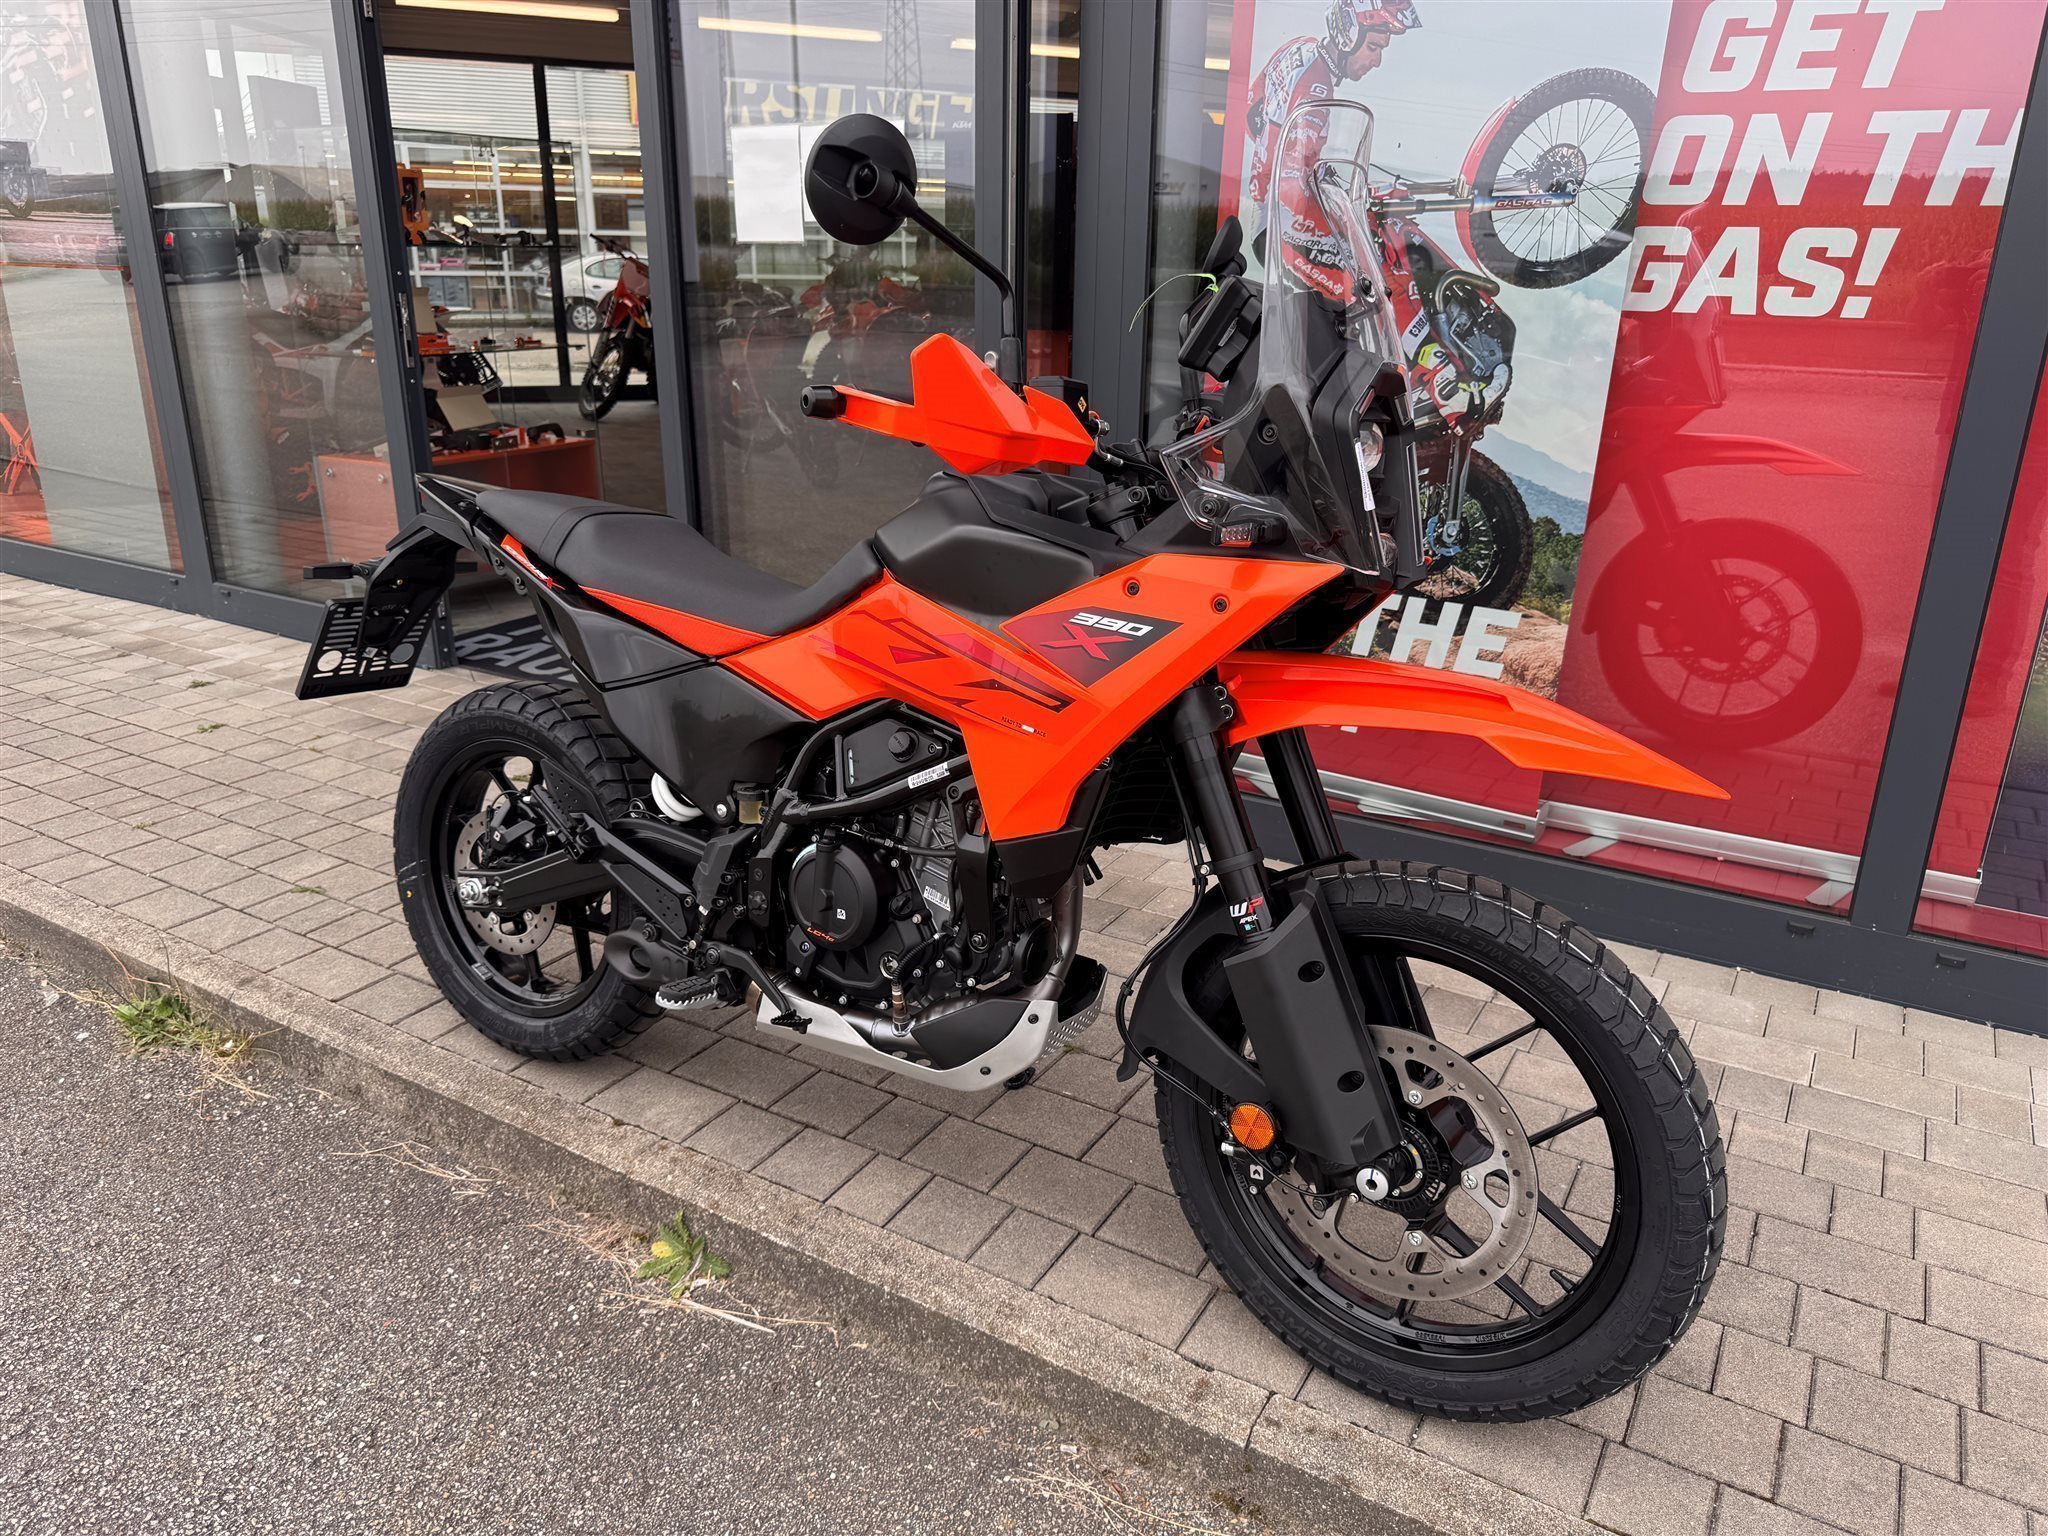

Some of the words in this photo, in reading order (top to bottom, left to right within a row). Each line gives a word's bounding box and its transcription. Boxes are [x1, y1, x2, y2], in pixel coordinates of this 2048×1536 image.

[1682, 0, 1945, 93] GET
[1642, 112, 1833, 206] ON
[1862, 108, 2025, 206] TH
[1495, 196, 1554, 209] GASGAS
[1621, 225, 1901, 319] GAS!
[1040, 623, 1134, 661] X
[1068, 612, 1154, 637] 390
[1350, 594, 1522, 680] THE
[454, 633, 579, 684] RAC
[1230, 897, 1264, 918] WP
